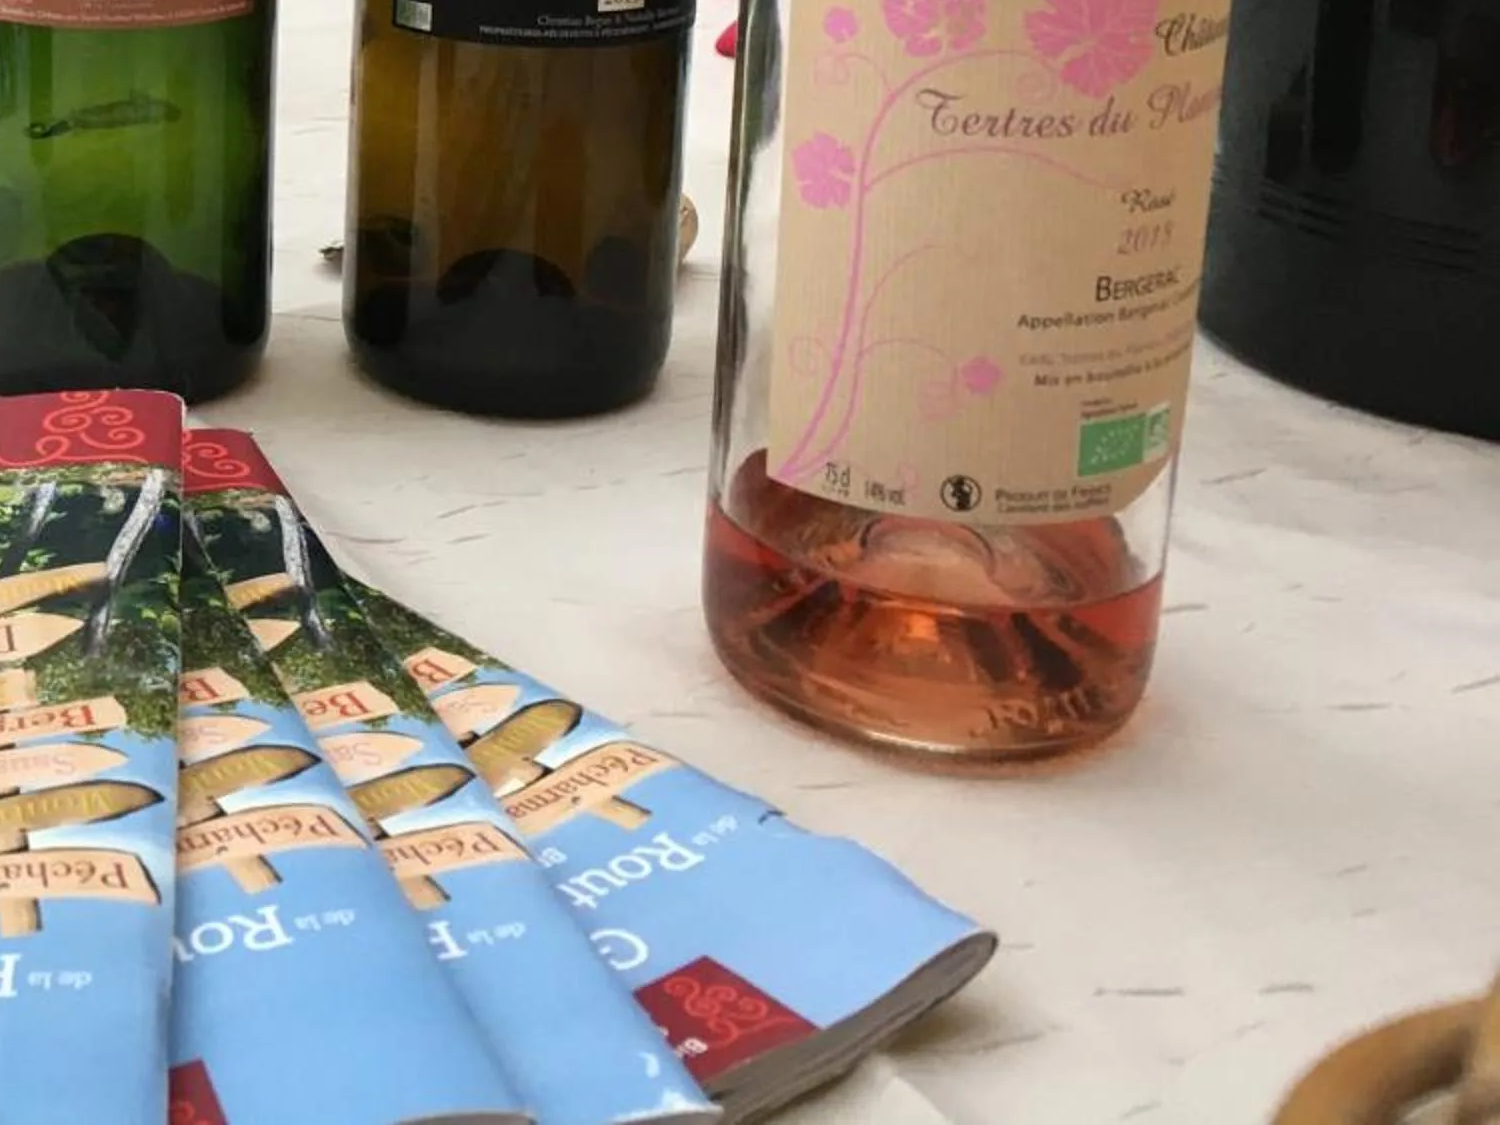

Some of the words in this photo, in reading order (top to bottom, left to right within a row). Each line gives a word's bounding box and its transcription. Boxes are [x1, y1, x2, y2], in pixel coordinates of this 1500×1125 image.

[916, 87, 1076, 138] Tertres
[1088, 94, 1134, 137] du
[1018, 311, 1115, 331] Appellation
[503, 747, 659, 822] Pécharma
[555, 831, 705, 911] Rout
[320, 908, 356, 927] de
[26, 970, 56, 992] la
[59, 968, 94, 991] de
